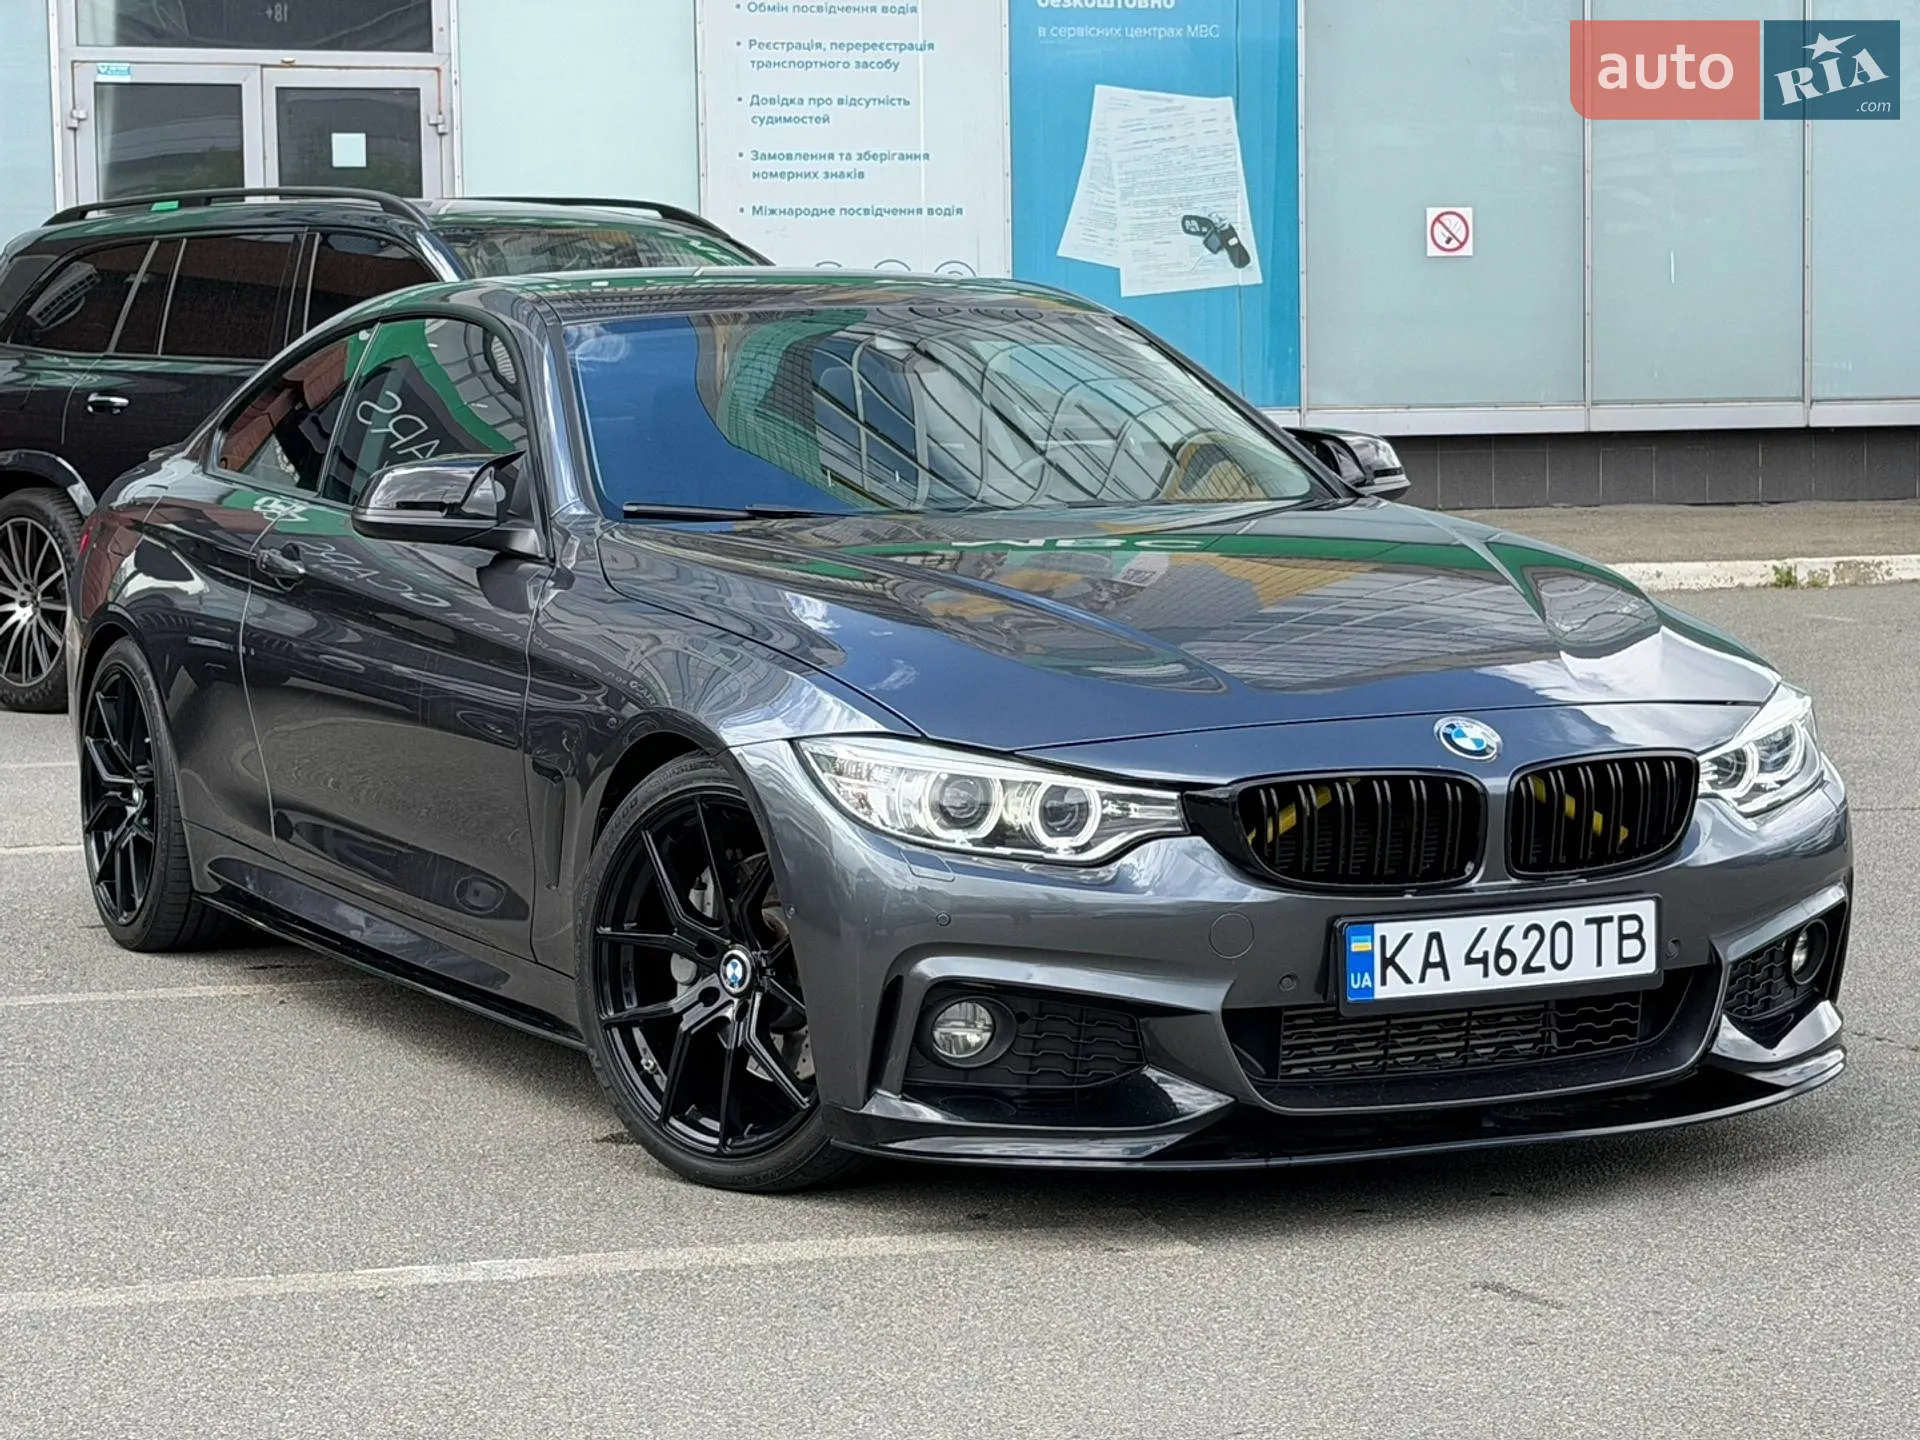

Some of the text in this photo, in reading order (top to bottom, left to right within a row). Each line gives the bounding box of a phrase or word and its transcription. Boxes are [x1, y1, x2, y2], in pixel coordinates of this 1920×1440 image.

[747, 2, 918, 15] Обмін посвідчення водія
[1037, 25, 1220, 39] в сервісних центрах МВС
[750, 39, 935, 53] Реєстрація, перереєстрація
[750, 59, 900, 72] транспортного засобу
[750, 94, 911, 108] Довідка про відсутність
[751, 114, 830, 126] судимостей
[750, 150, 930, 164] Замовлення та зберігання
[752, 168, 865, 181] номерних знаків
[752, 205, 963, 217] Міжнародне посвідчення водія
[1464, 920, 1574, 978] 4620
[1350, 973, 1372, 989] UA
